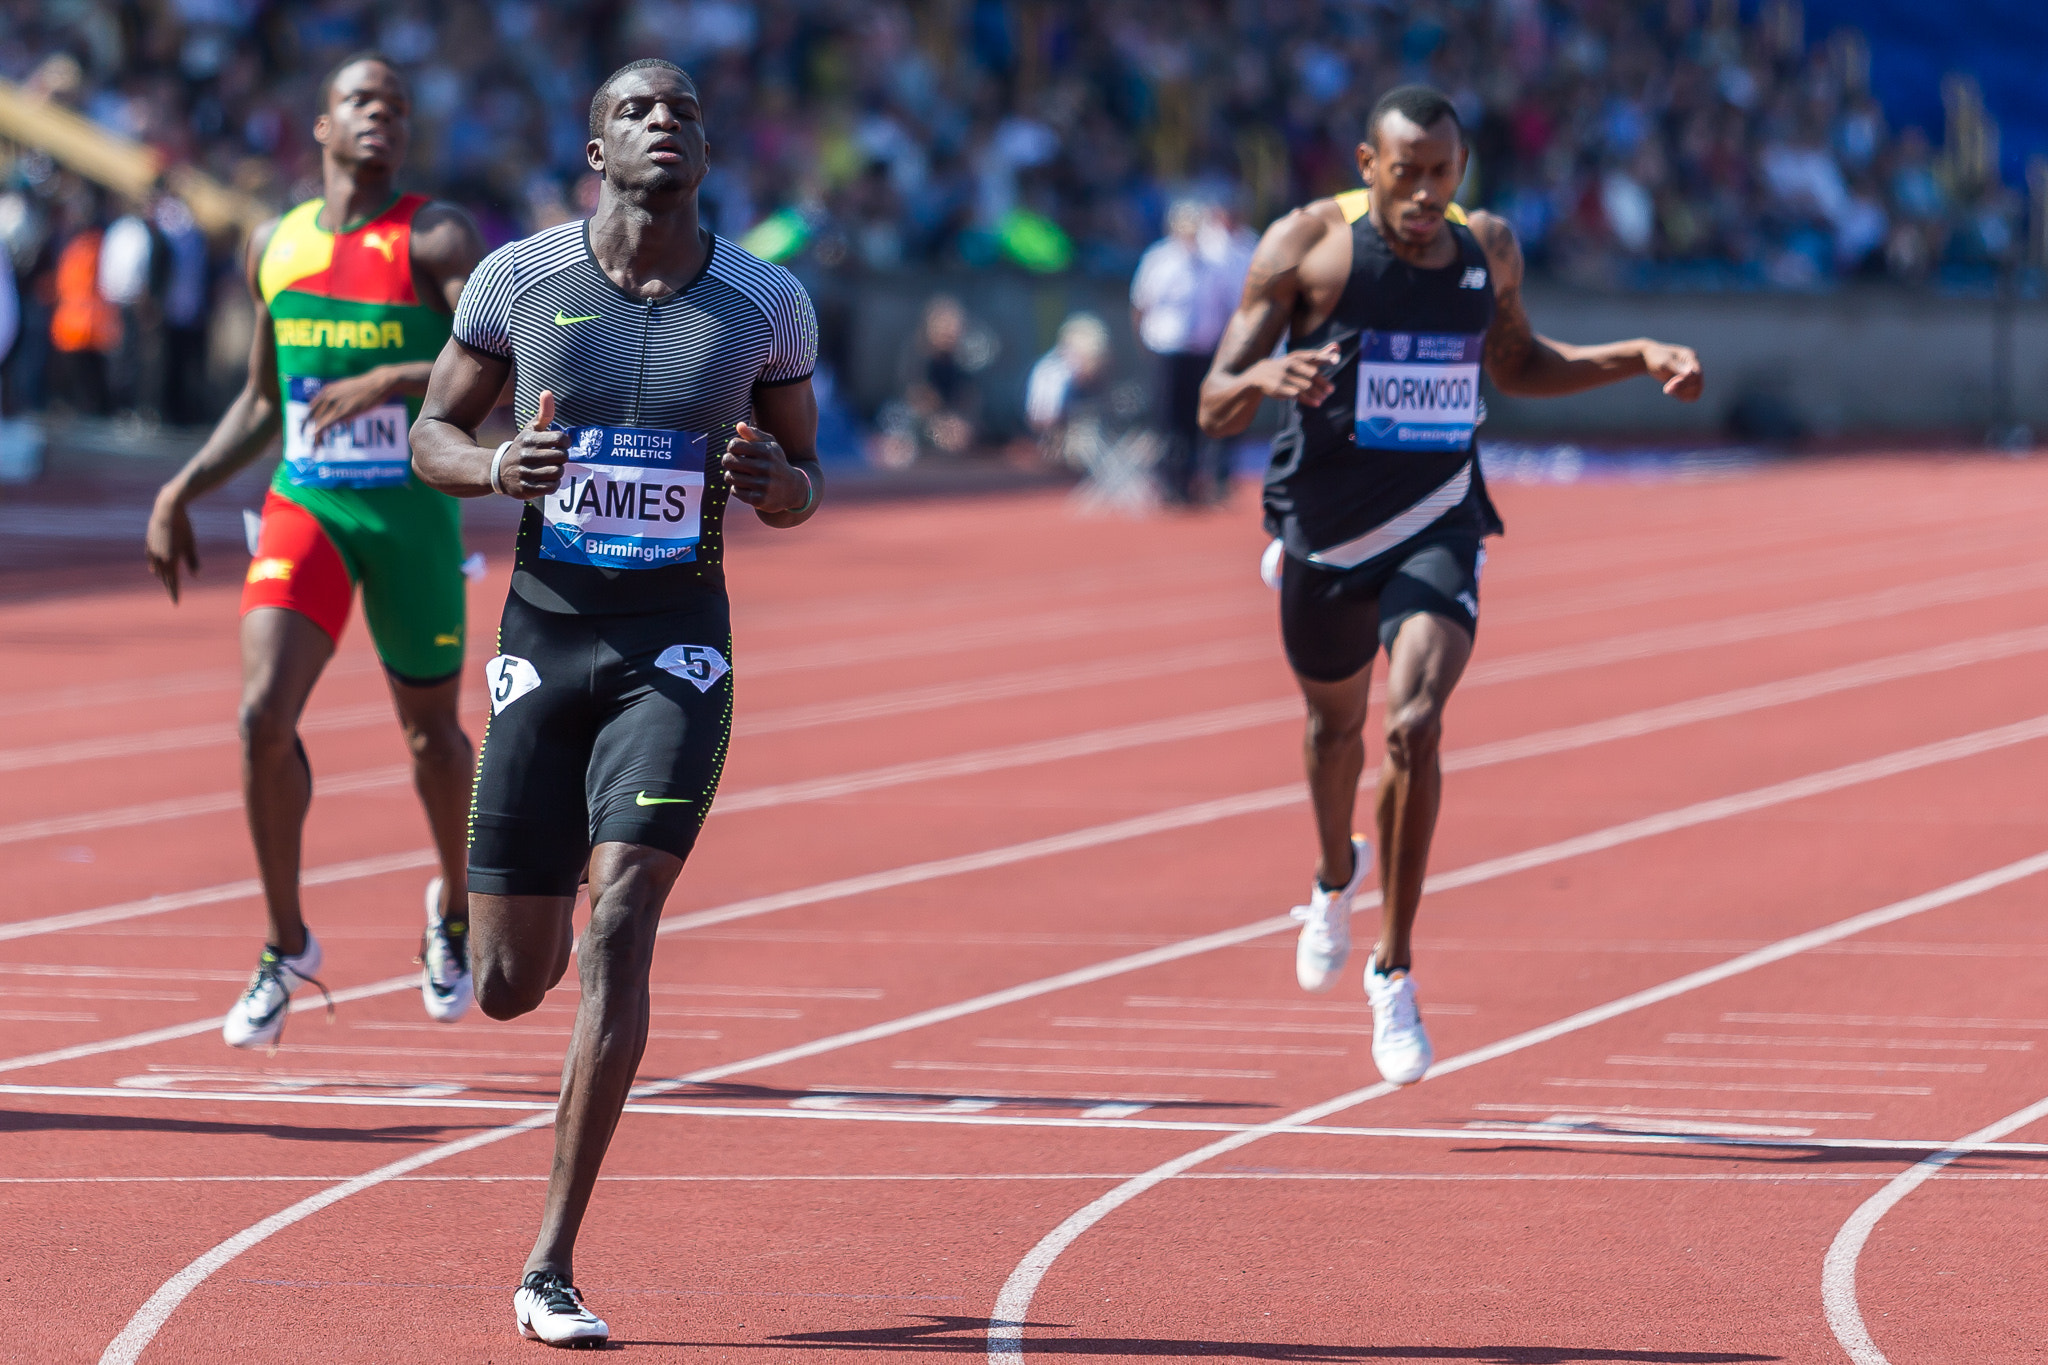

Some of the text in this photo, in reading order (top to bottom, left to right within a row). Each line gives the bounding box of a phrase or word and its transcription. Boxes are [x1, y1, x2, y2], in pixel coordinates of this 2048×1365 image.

[1367, 376, 1471, 410] NORWOOD
[613, 433, 672, 449] BRITISH
[1398, 427, 1472, 444] Birmingha
[610, 447, 672, 460] ATHLETICS
[559, 476, 687, 523] JAMES
[495, 657, 518, 702] 5
[682, 647, 711, 681] 5
